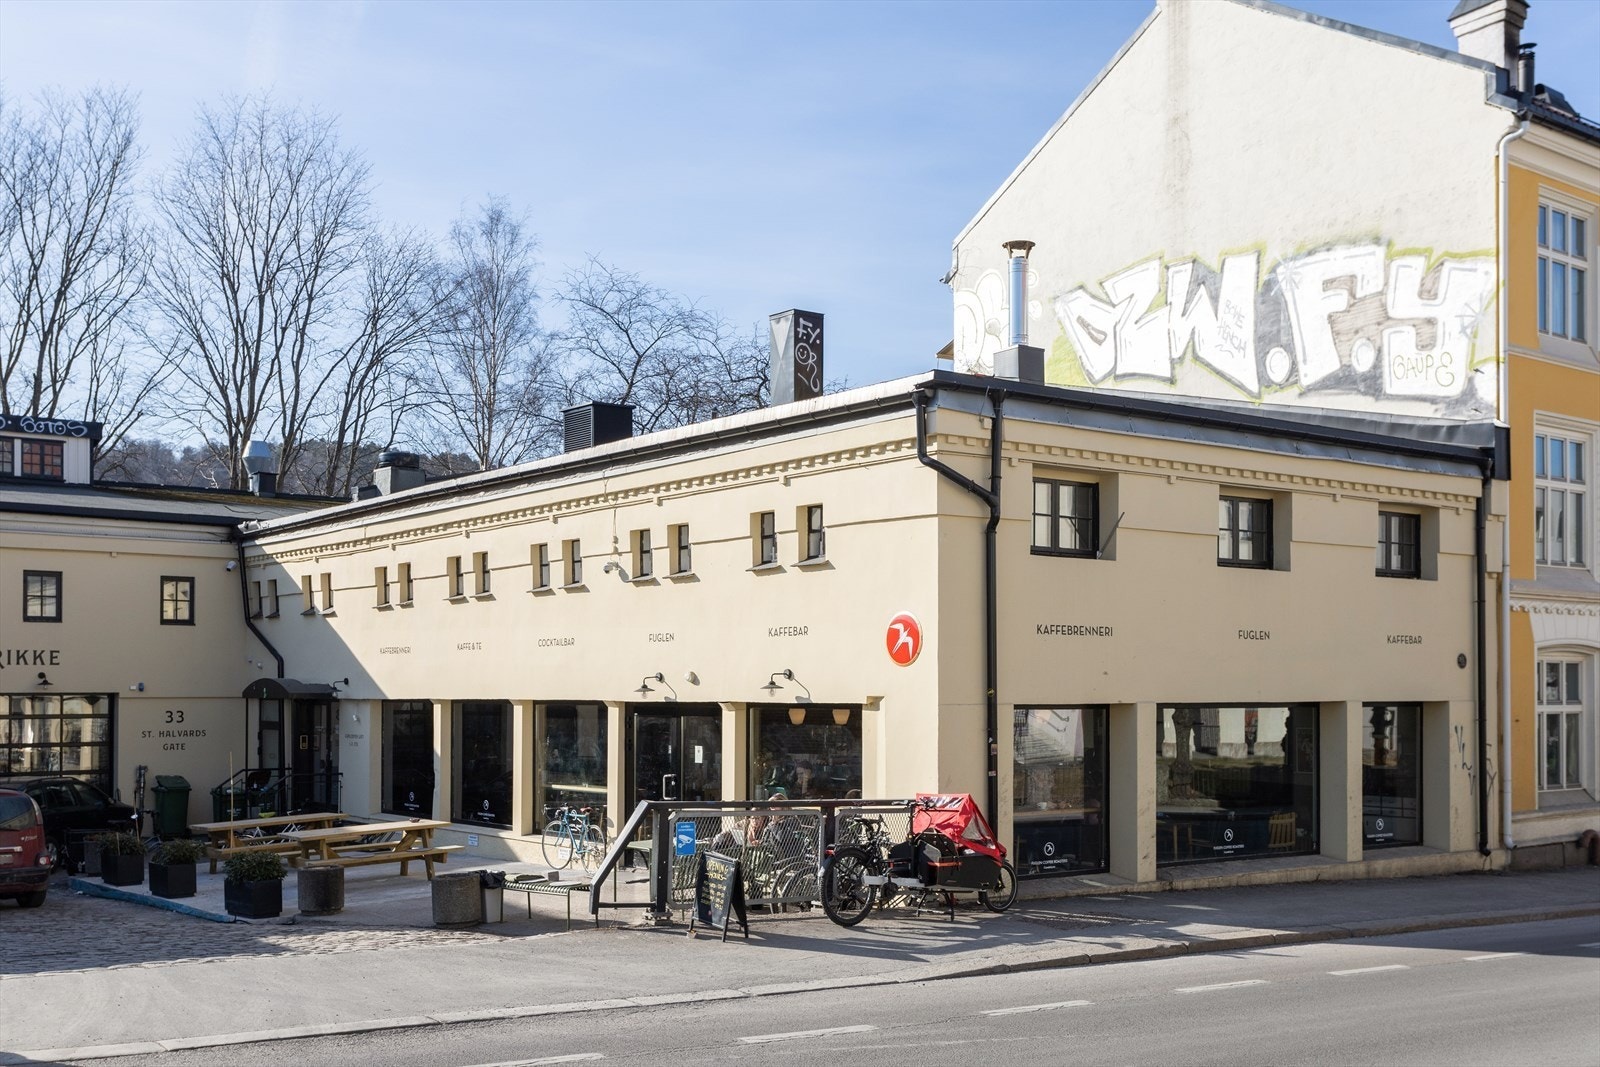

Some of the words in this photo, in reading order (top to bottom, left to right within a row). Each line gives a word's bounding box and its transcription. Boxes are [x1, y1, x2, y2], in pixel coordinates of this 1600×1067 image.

[768, 626, 809, 637] KAFFEBAR
[1036, 624, 1113, 636] KAFFEBRENNERI
[649, 633, 675, 642] FUGLEN
[1238, 630, 1271, 640] FUGLEN
[1386, 635, 1422, 644] KAFFEBAR
[476, 642, 482, 650] TE
[537, 638, 576, 647] COCKTAILBAR
[380, 646, 412, 654] KAFFEBRENNERI
[165, 710, 185, 723] 33
[141, 730, 155, 738] ST.
[159, 729, 207, 738] HALVARDS
